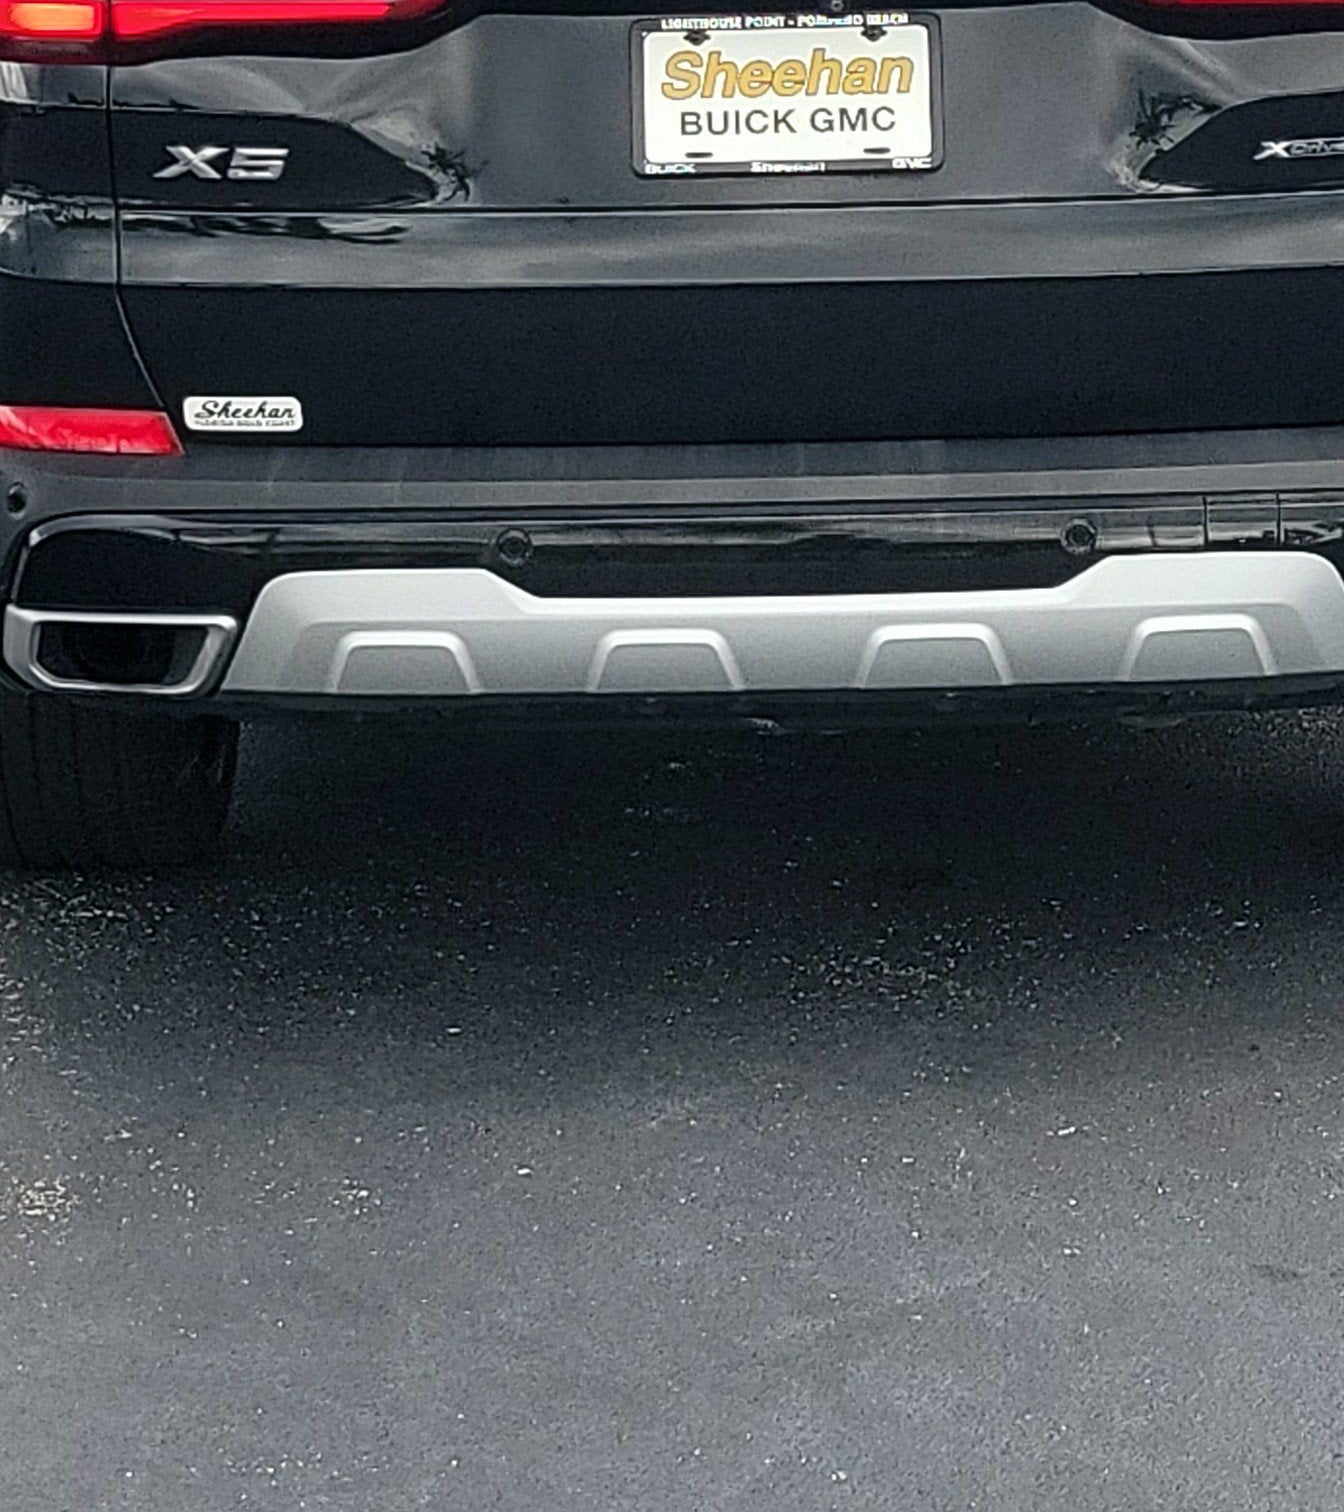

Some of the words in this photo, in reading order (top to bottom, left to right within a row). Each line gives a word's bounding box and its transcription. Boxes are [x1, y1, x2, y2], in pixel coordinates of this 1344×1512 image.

[660, 48, 914, 100] Sheehan
[680, 109, 798, 136] BUICK
[809, 105, 897, 132] GMC
[152, 145, 290, 180] X5
[194, 400, 295, 419] Sheehan
